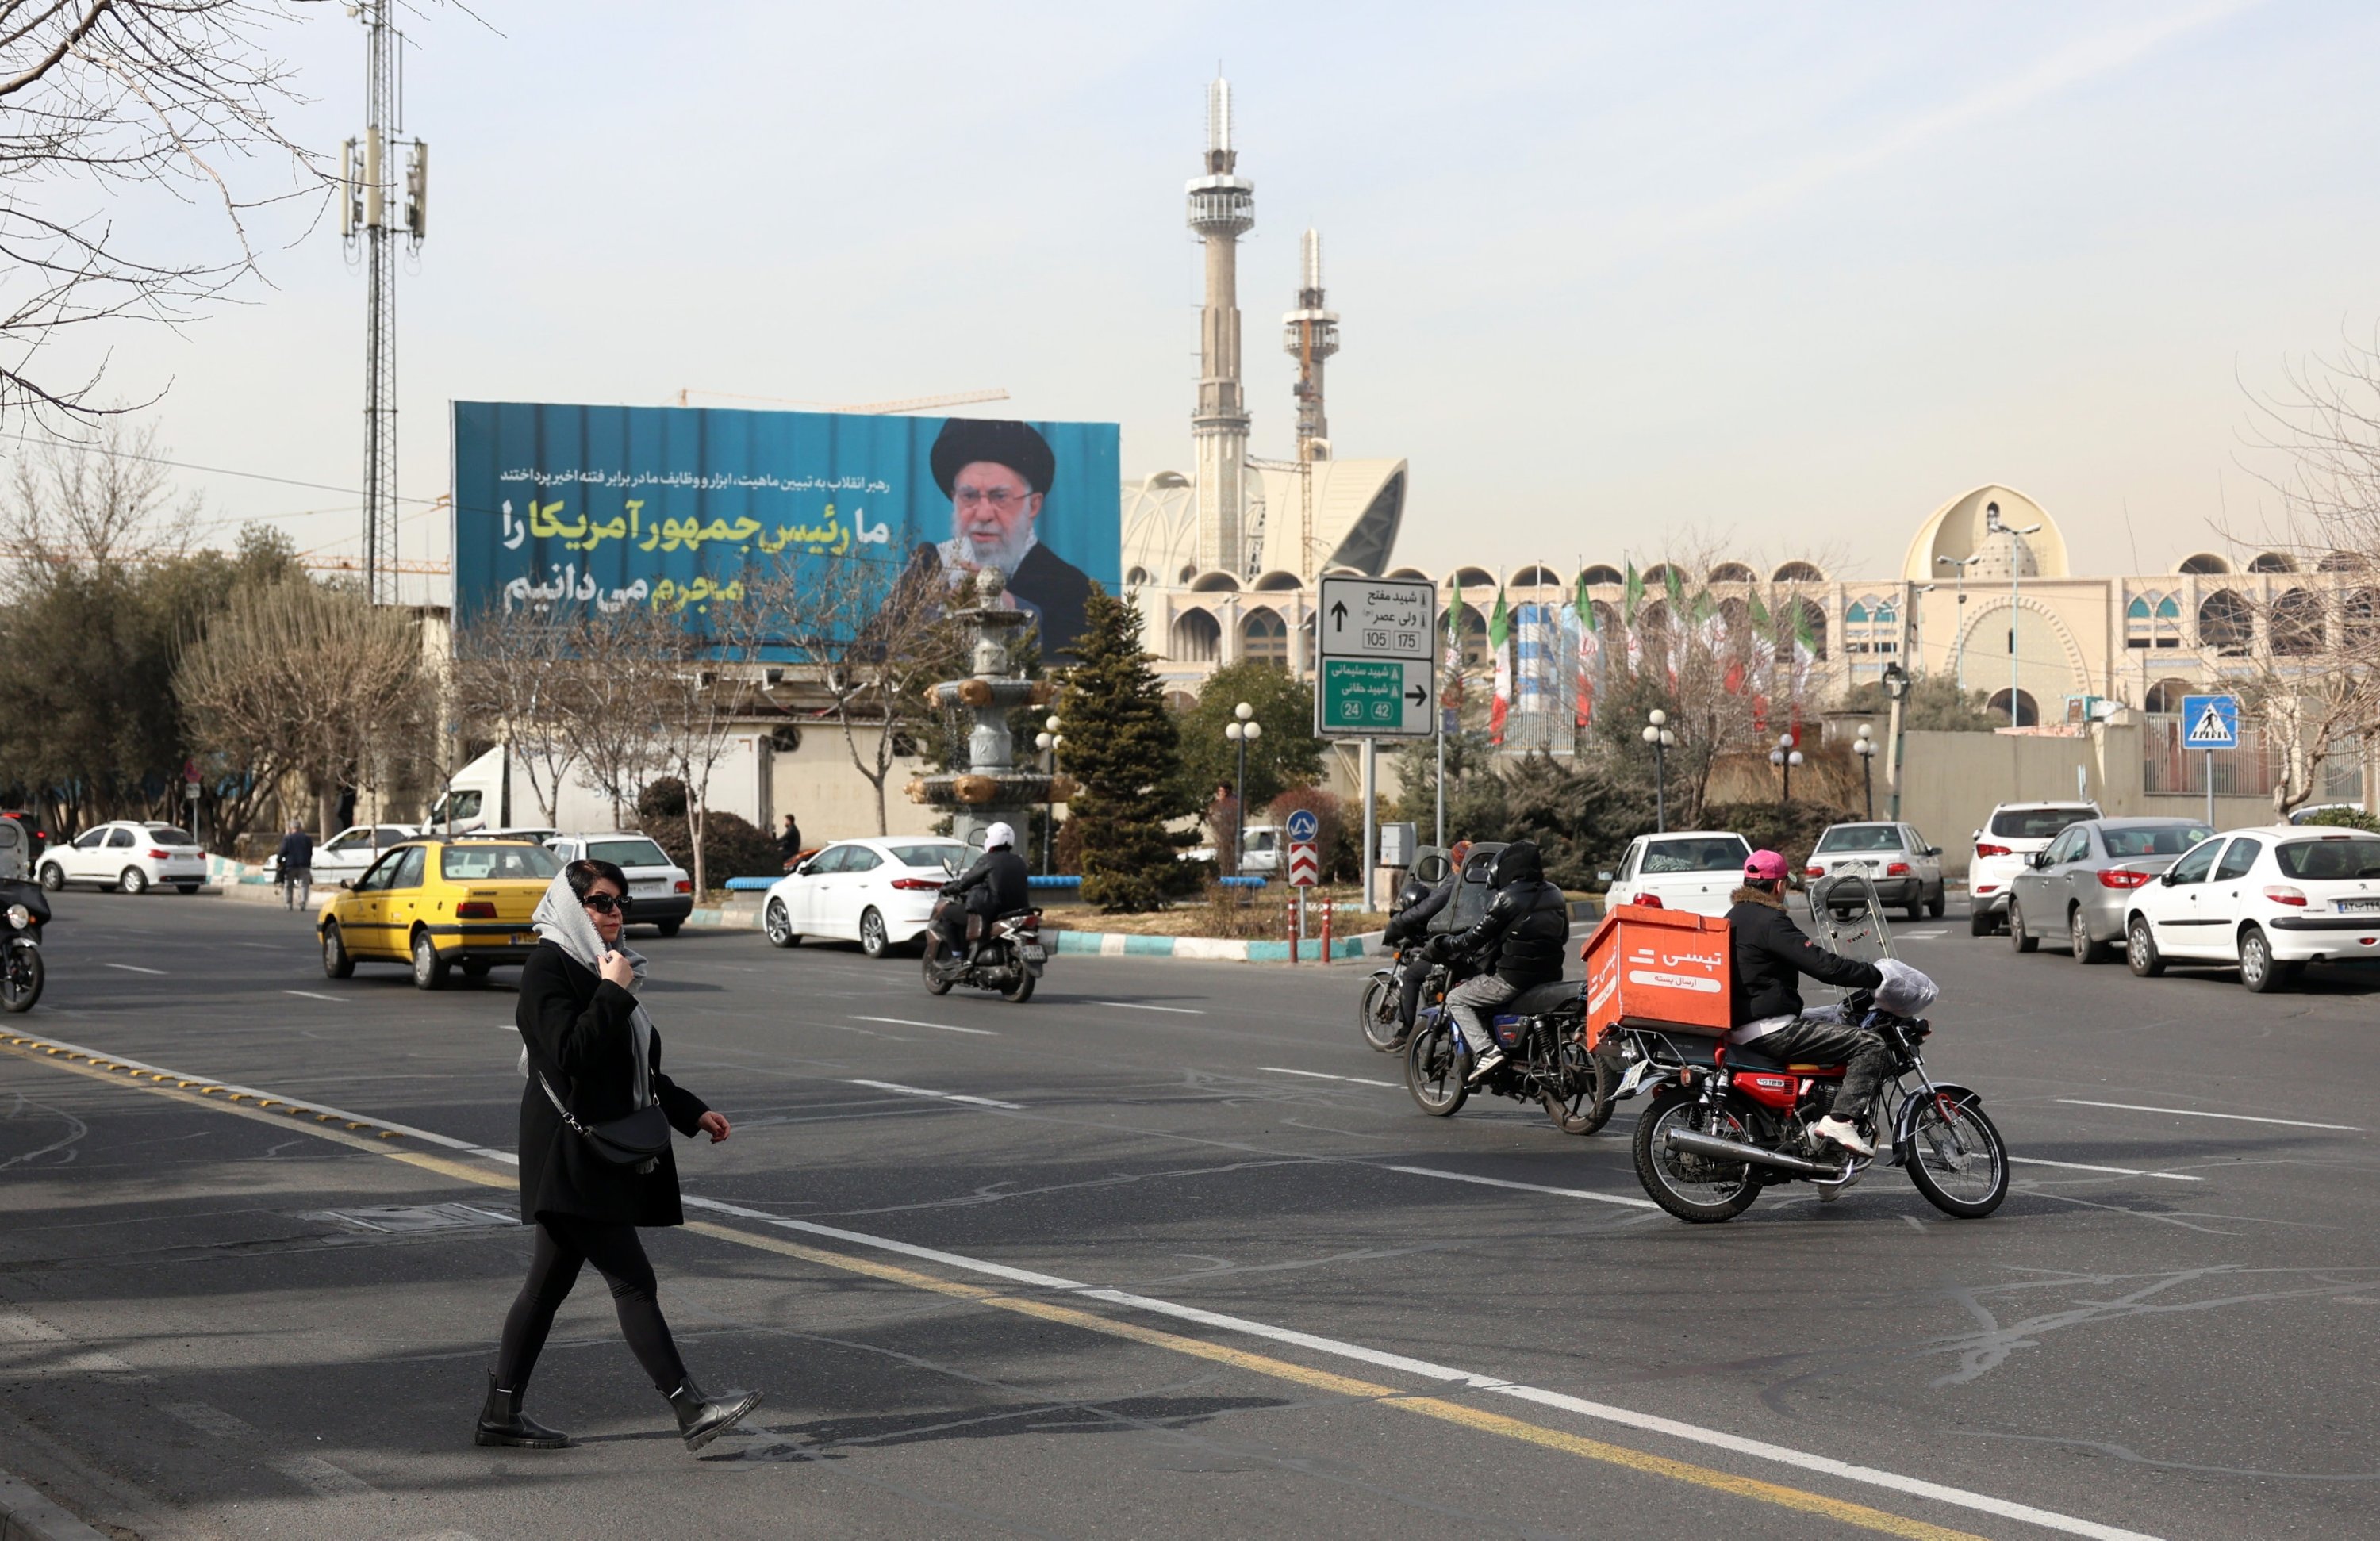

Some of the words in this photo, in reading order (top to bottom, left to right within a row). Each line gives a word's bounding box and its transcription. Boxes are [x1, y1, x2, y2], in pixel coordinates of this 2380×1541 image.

[500, 468, 551, 487] پرداختند
[551, 469, 578, 486] اخیر
[579, 469, 605, 483] فتنه
[605, 470, 631, 488] برابر
[631, 473, 646, 487] در
[646, 471, 659, 485] ما
[660, 471, 701, 489] وظایف
[709, 472, 731, 489] ابزار
[781, 475, 812, 491] تبیین
[827, 476, 865, 491] انقلاب
[814, 477, 826, 492] به
[865, 478, 890, 493] رهبر
[502, 499, 525, 550] را
[528, 499, 645, 551] آمریکا
[758, 503, 850, 555] رئیس
[854, 507, 890, 544] ما
[639, 516, 762, 554] جمهور
[651, 577, 745, 614] مجرم
[1368, 589, 1391, 606] مفتح
[1392, 590, 1417, 605] شهید
[1372, 614, 1395, 625] عصر
[1399, 611, 1417, 627] ولی
[1366, 632, 1387, 646] 105
[1398, 634, 1416, 648] 175
[1368, 665, 1389, 679] شهید
[1367, 682, 1388, 696] شهید
[1345, 703, 1359, 716] 24
[1375, 704, 1388, 718] 42
[1662, 952, 1722, 972] تپسی
[1654, 975, 1674, 985] بسته
[1676, 976, 1697, 987] ارسال
